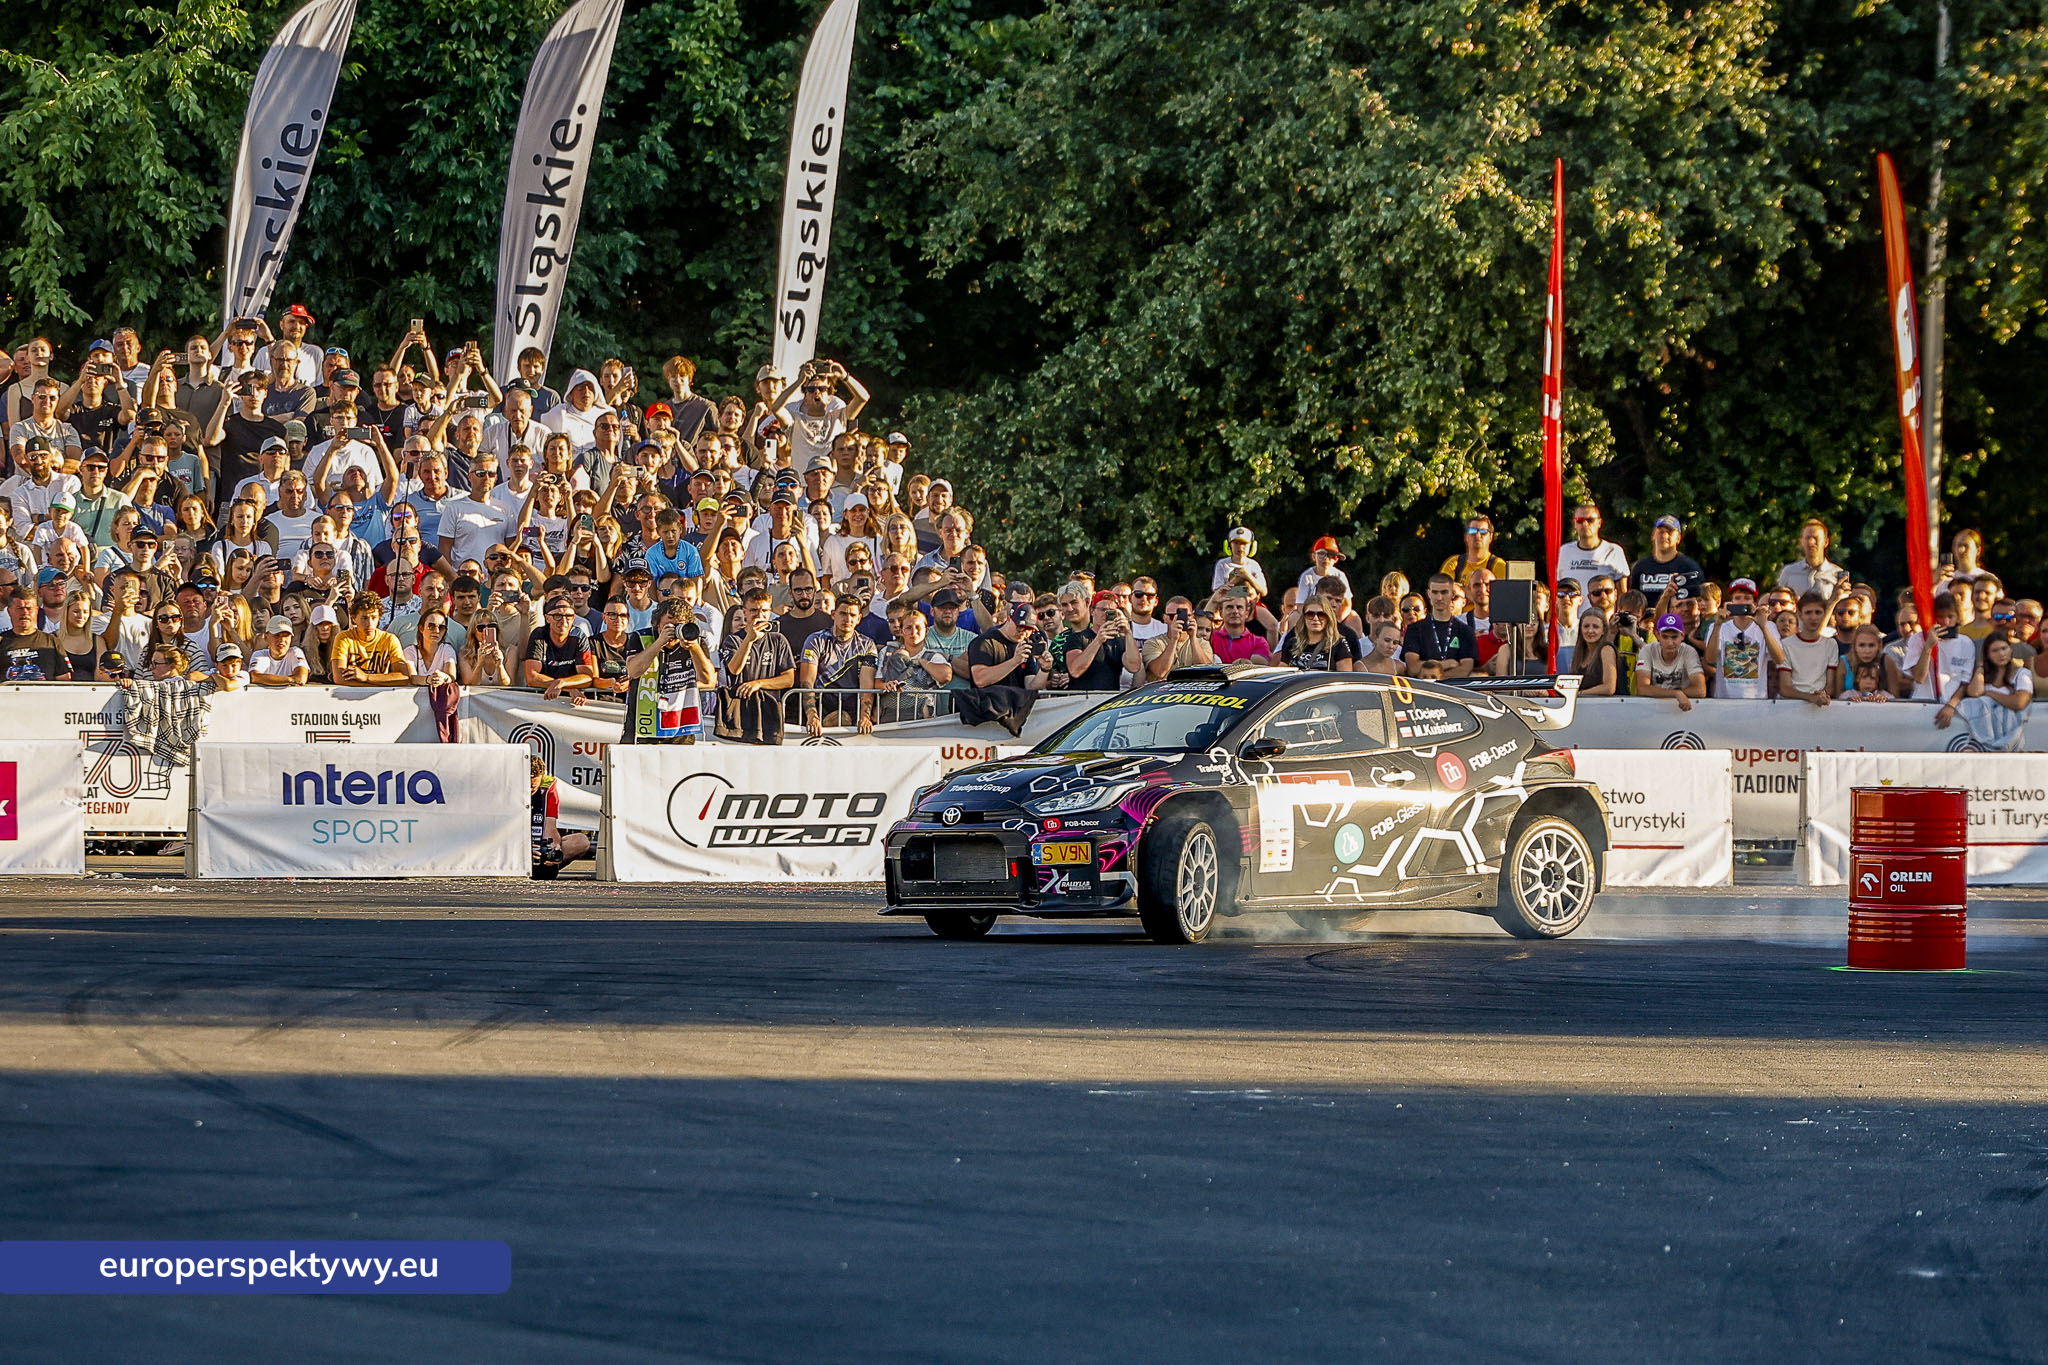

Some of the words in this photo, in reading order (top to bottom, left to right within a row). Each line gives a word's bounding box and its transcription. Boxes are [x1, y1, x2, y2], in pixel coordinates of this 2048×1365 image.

[1151, 694, 1249, 709] CONTROL
[64, 712, 112, 725] STADION
[291, 713, 339, 726] STADION
[342, 711, 381, 729] ŚLĄSKI
[639, 709, 653, 735] POL
[1468, 738, 1519, 772] FOB-Decor
[282, 763, 446, 805] interia
[983, 784, 1012, 795] Group
[1733, 774, 1799, 793] TADION
[1967, 786, 2046, 802] sterstwo
[717, 792, 888, 820] MOTO
[1064, 820, 1100, 828] FOB-Decor
[1991, 809, 1997, 825] i
[311, 819, 419, 844] SPORT
[712, 826, 872, 846] WIZJA
[1042, 845, 1054, 862] S
[1058, 844, 1089, 861] V9N
[1889, 871, 1933, 882] ORLEN
[1889, 884, 1906, 893] OIL
